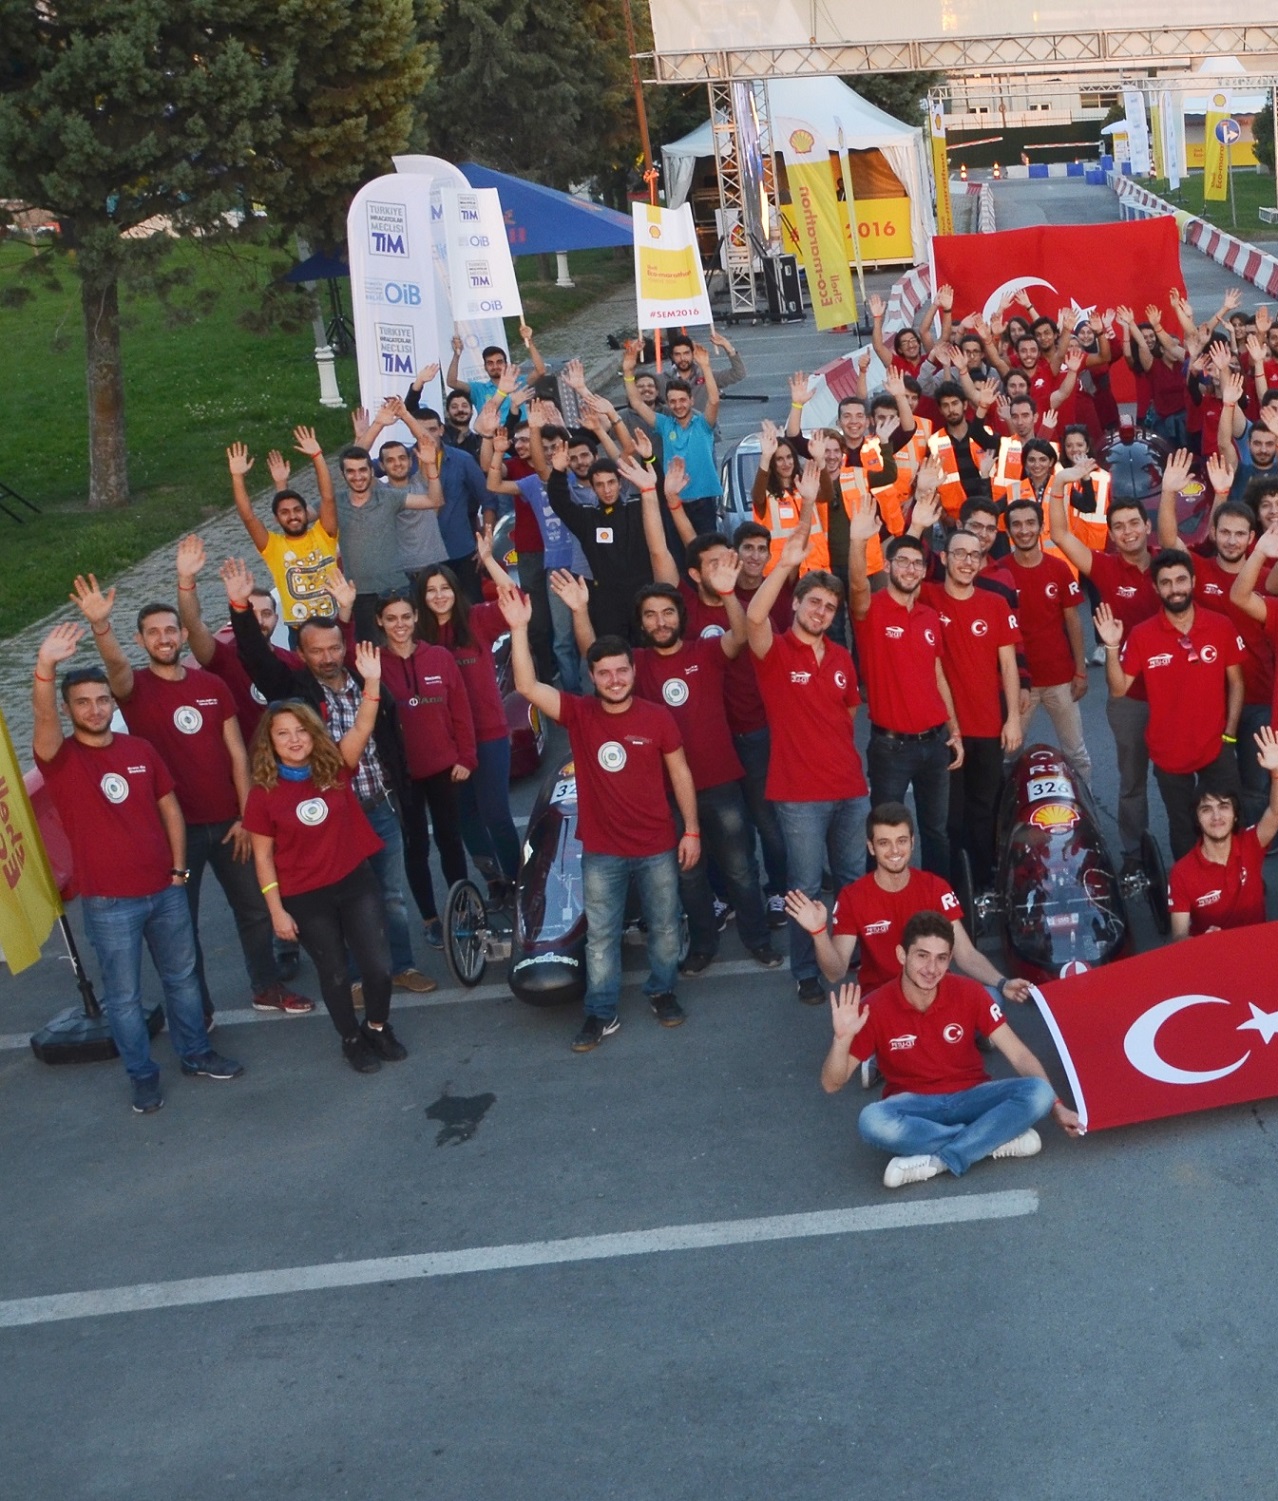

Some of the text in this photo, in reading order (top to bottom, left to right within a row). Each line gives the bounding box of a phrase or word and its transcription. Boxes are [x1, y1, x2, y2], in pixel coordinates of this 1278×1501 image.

[650, 308, 700, 318] #SEM2016
[556, 784, 577, 798] 32
[1033, 781, 1069, 796] 326
